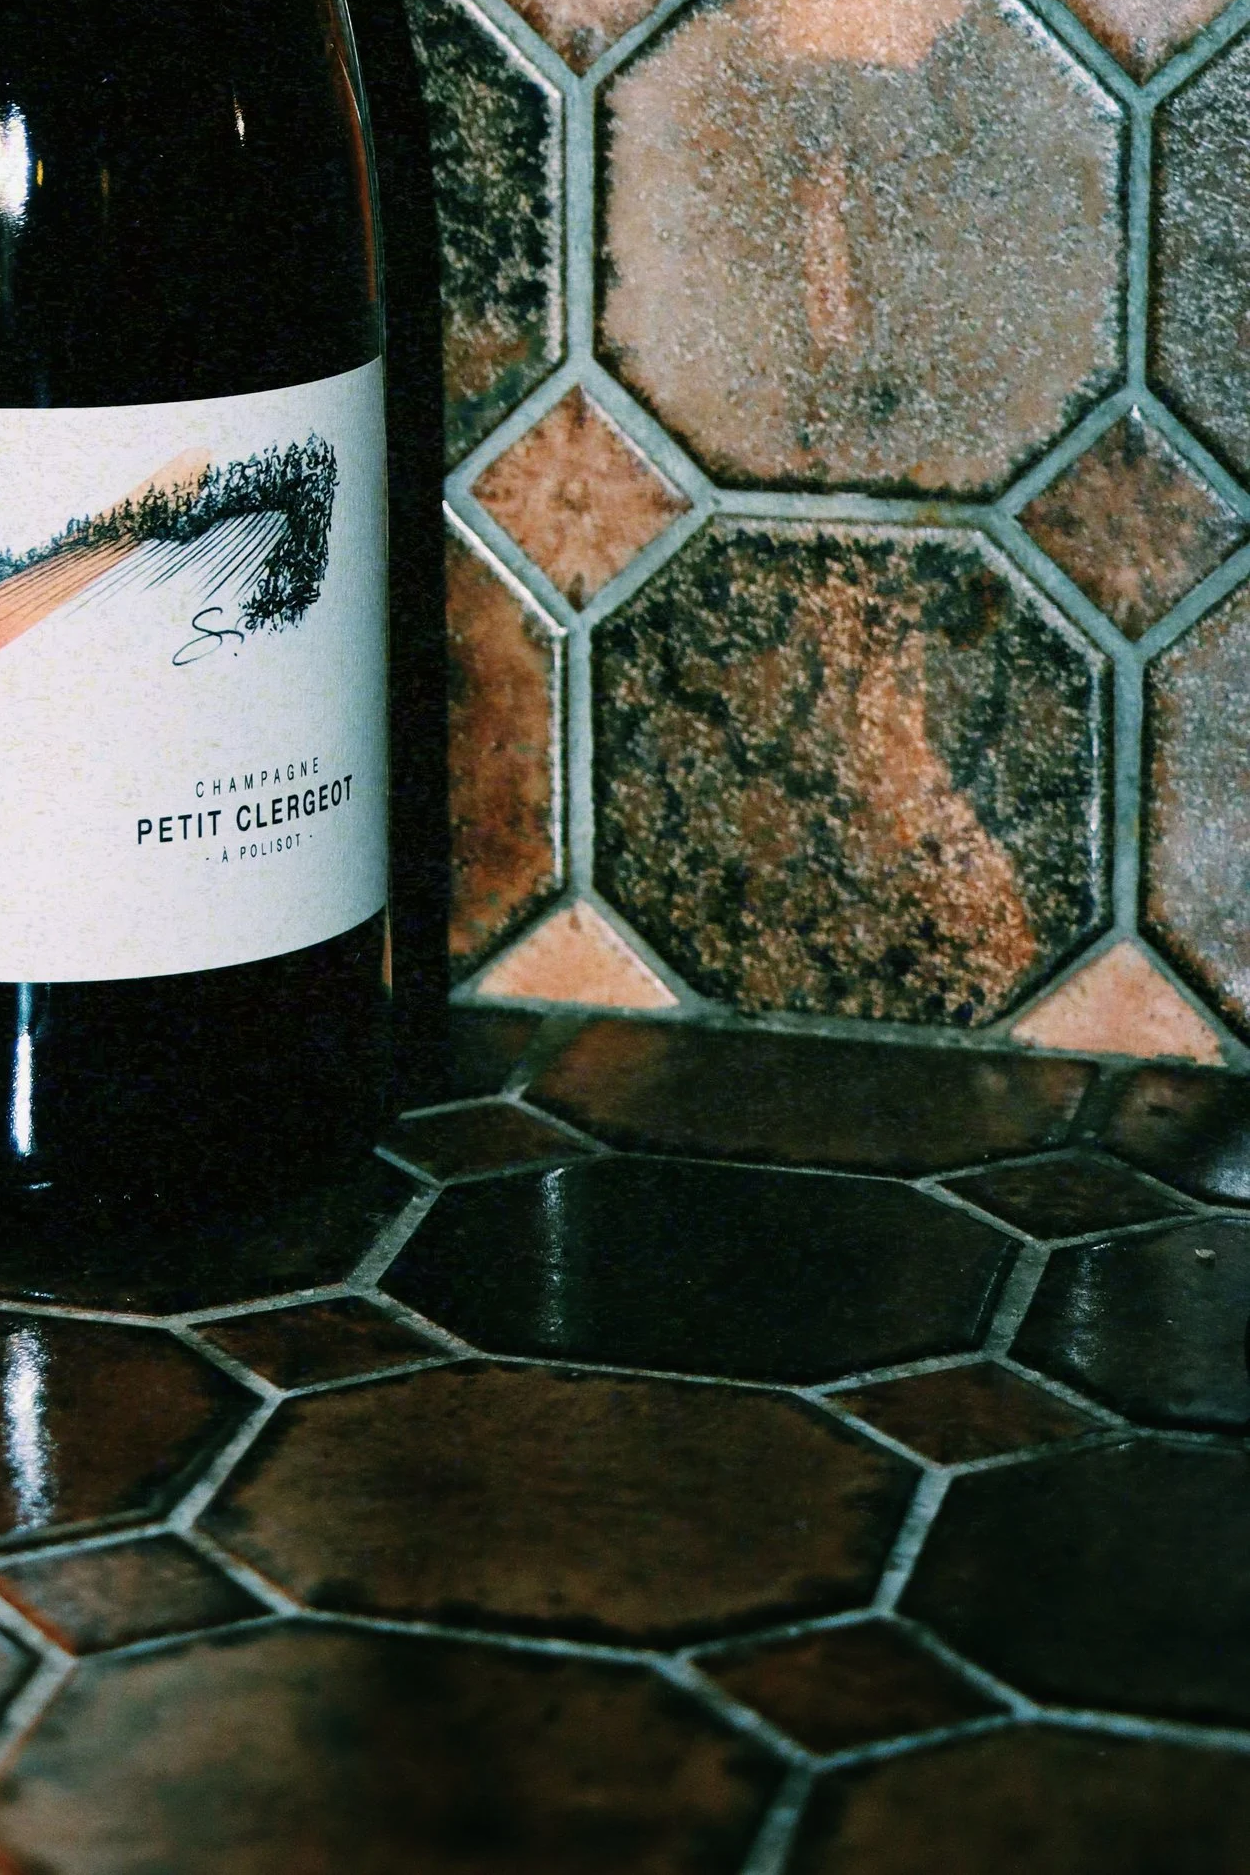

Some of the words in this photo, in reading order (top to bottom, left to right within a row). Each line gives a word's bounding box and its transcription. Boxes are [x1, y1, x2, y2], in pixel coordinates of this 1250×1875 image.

[196, 757, 319, 798] CHAMPAGNE
[137, 810, 221, 845] PETIT
[236, 775, 352, 831] CLERGEOT
[221, 846, 228, 863] À
[240, 833, 301, 860] POLISOT
